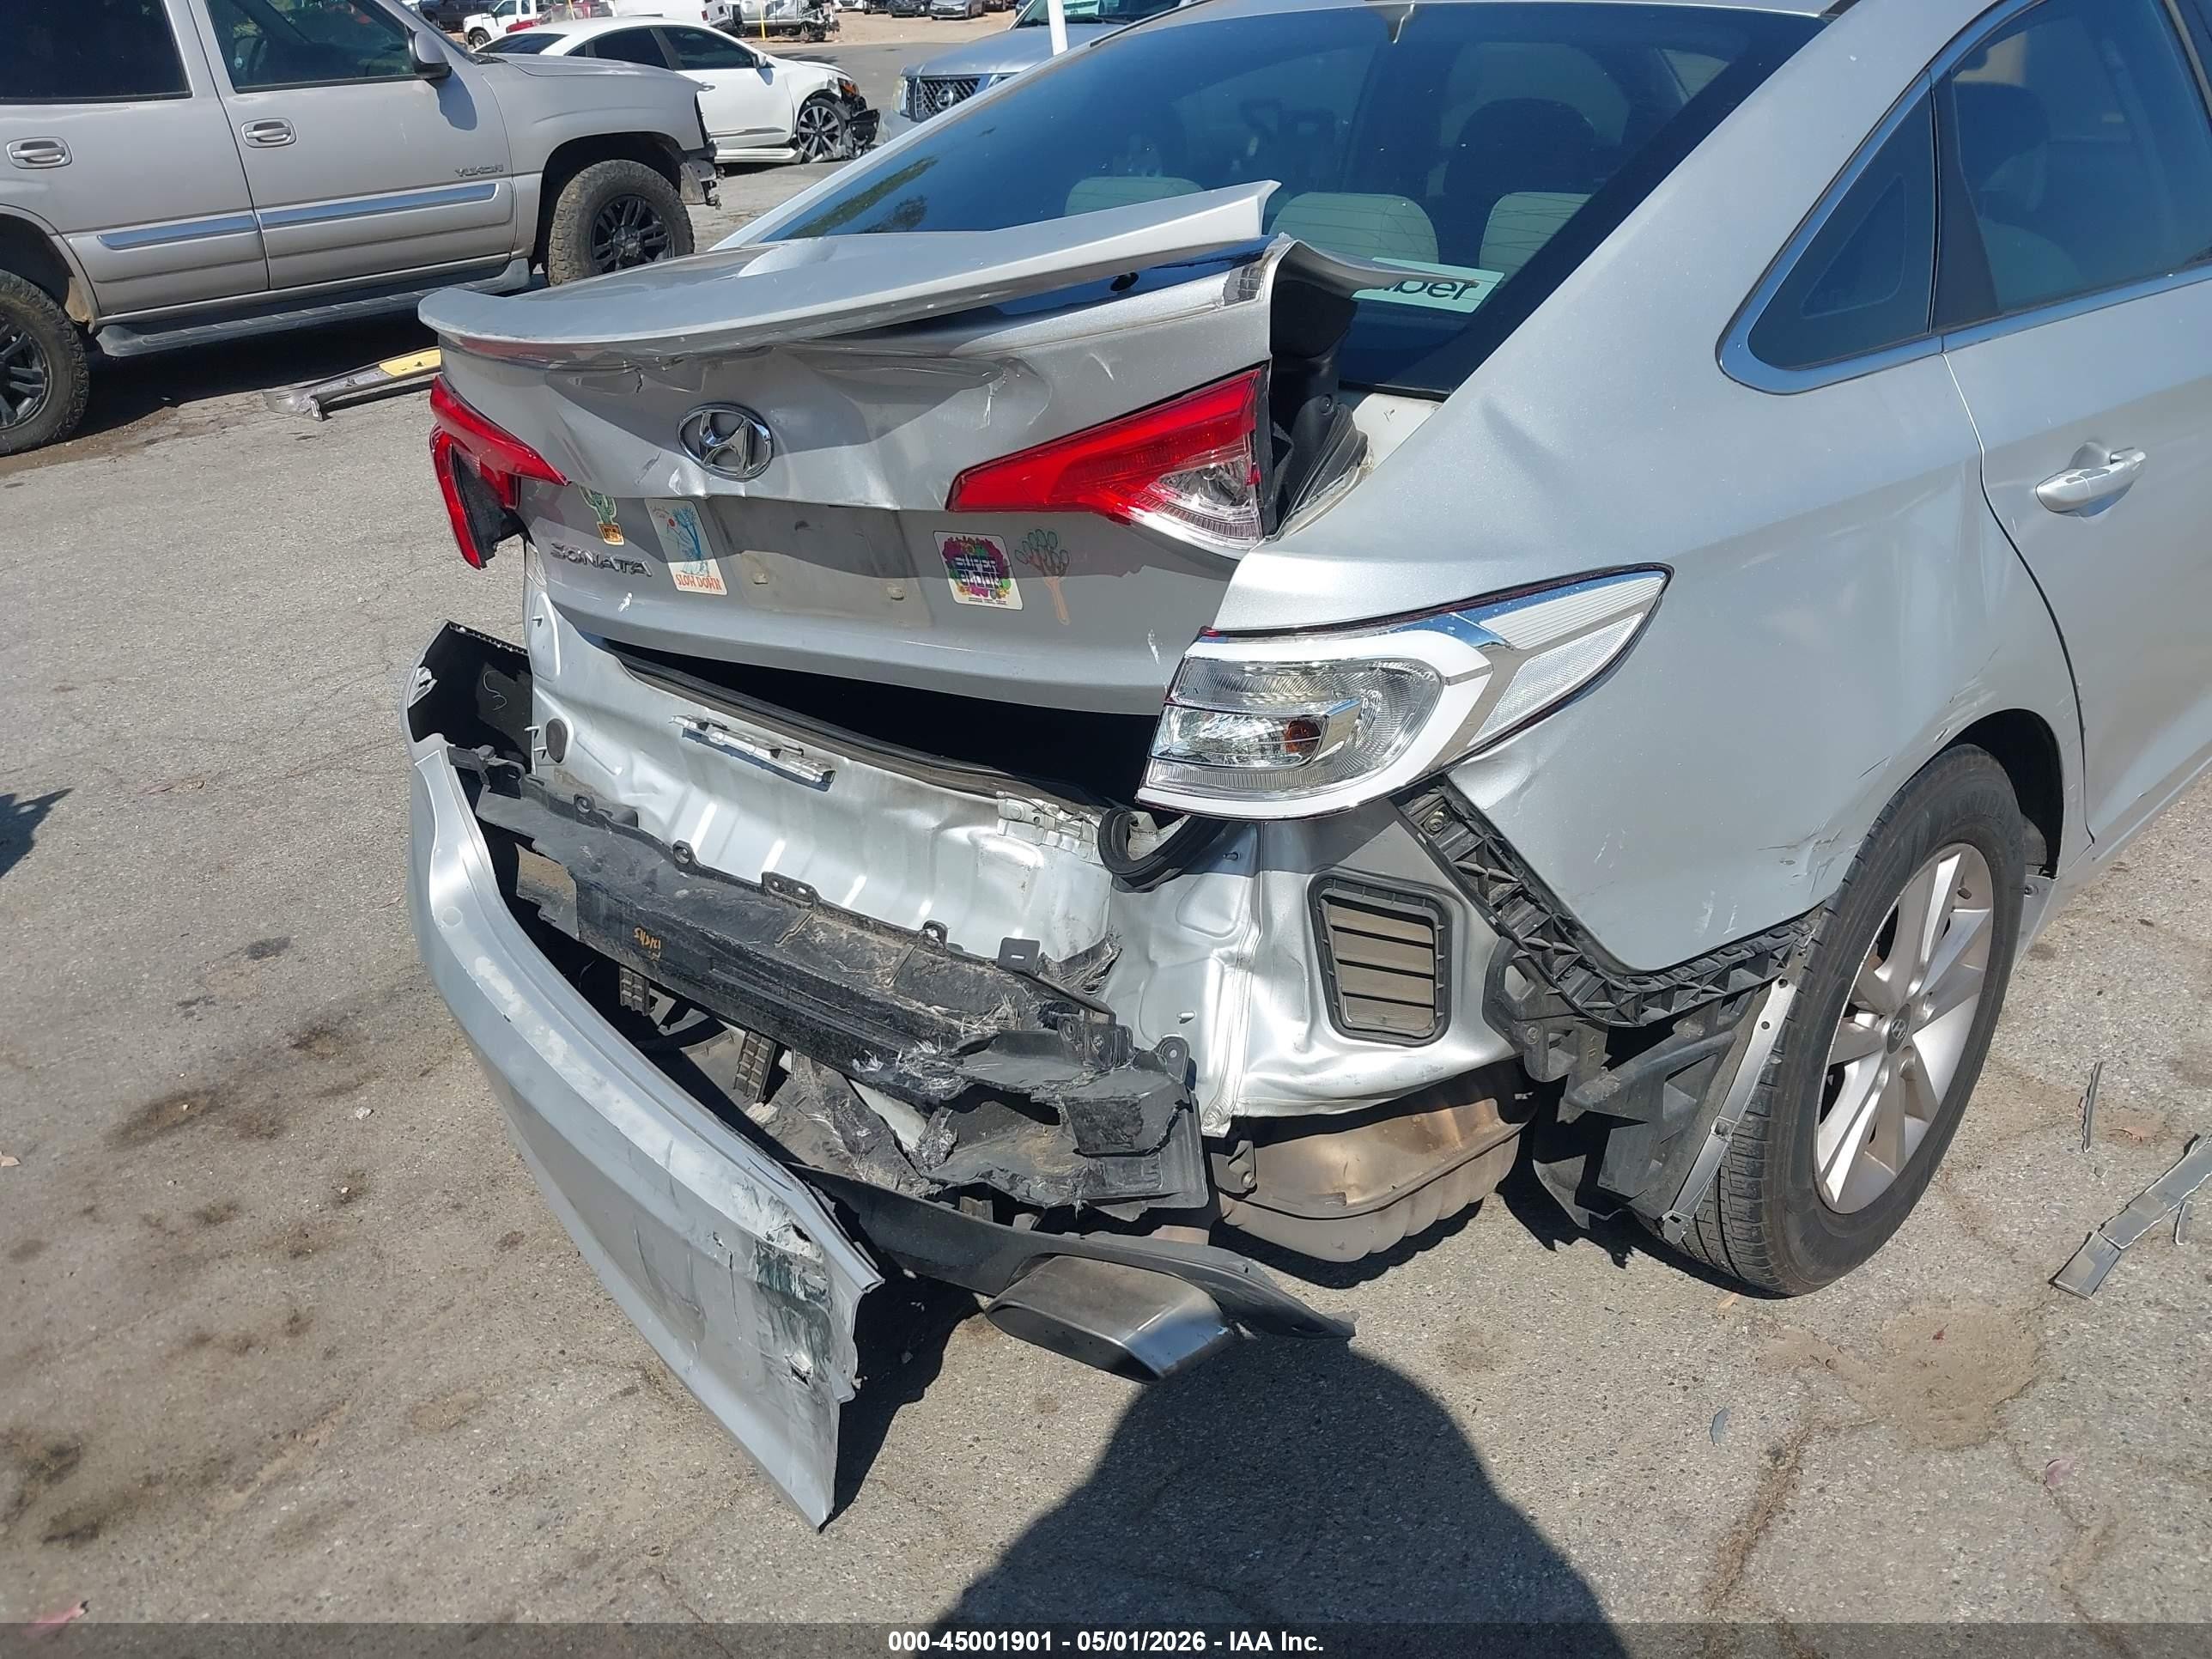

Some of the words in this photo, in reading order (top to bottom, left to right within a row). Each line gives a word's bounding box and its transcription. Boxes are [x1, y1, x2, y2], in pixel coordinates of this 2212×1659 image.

[550, 542, 653, 577] SONATA
[951, 553, 1000, 573] SUPER
[676, 574, 696, 587] SLOW
[696, 576, 722, 591] DOWN
